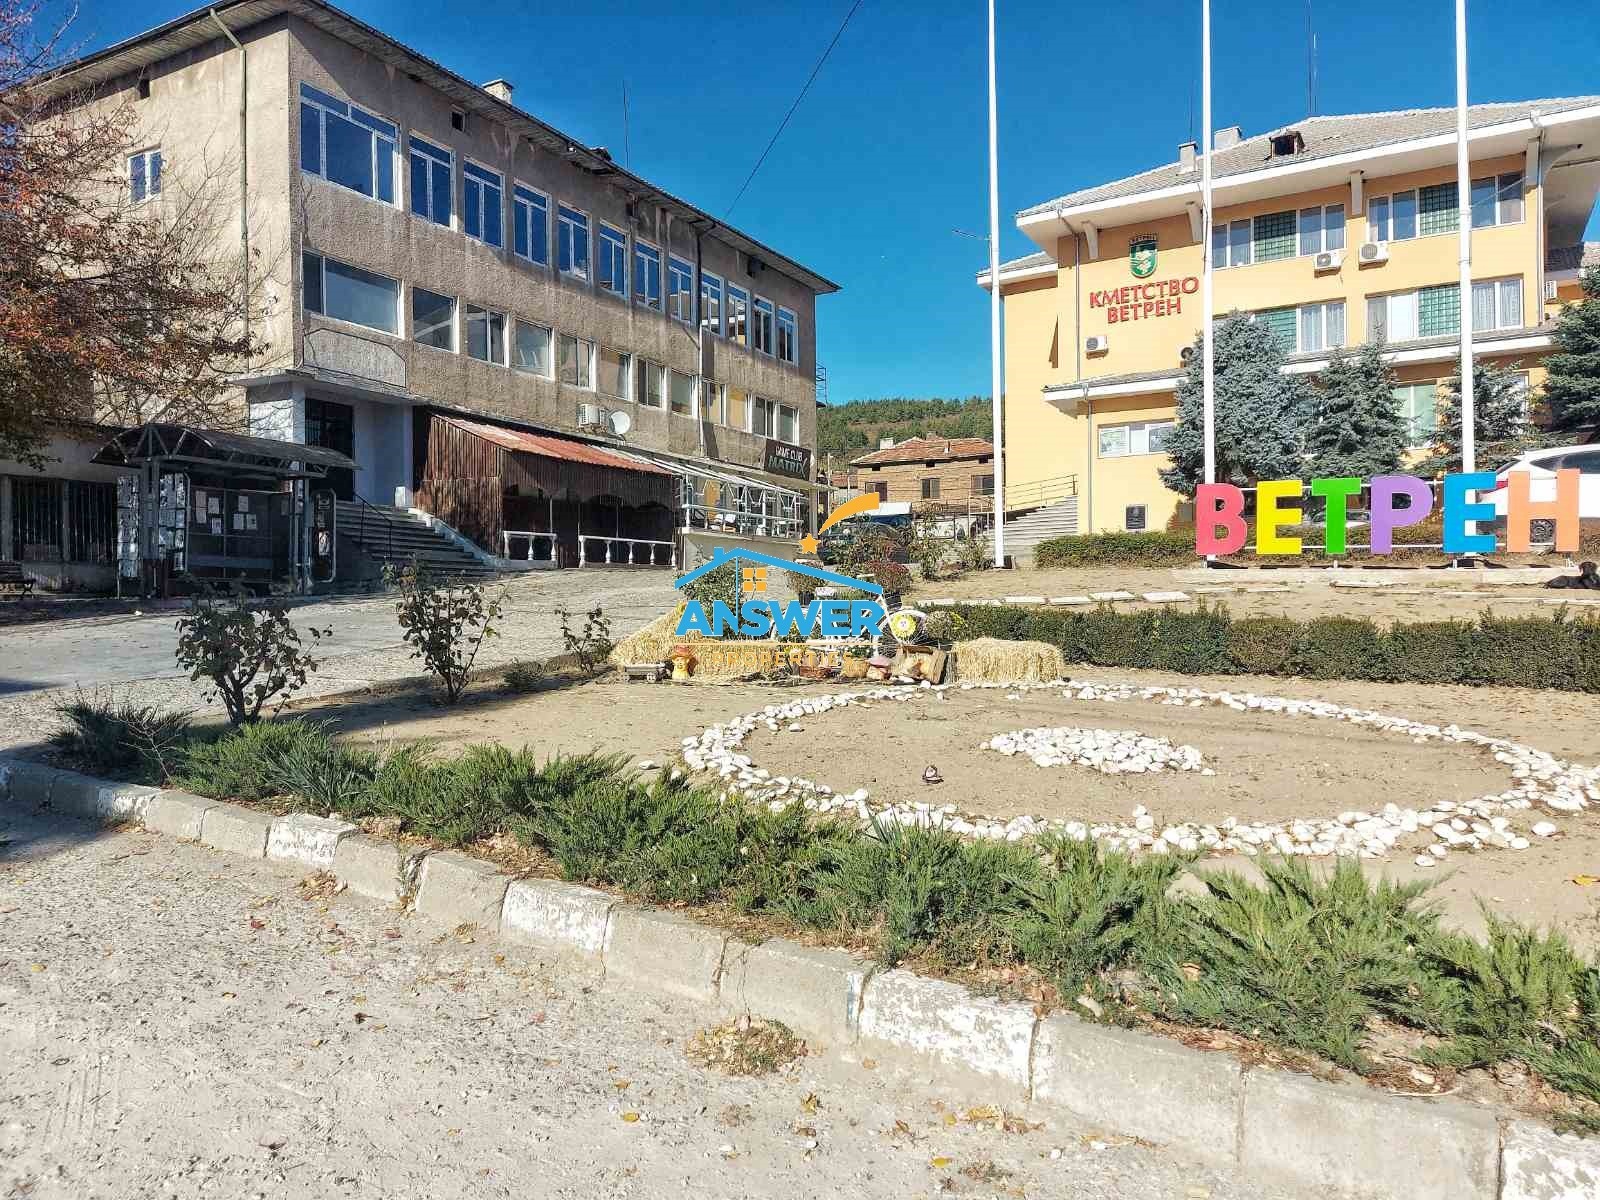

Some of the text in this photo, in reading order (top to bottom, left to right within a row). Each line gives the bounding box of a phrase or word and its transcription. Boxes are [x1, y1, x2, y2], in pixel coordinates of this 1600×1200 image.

[1089, 276, 1200, 309] КМЕТСТВО
[1107, 297, 1182, 324] ВЕТРЕН
[768, 456, 807, 479] MATRIX
[1195, 468, 1581, 555] ВЕТРЕН
